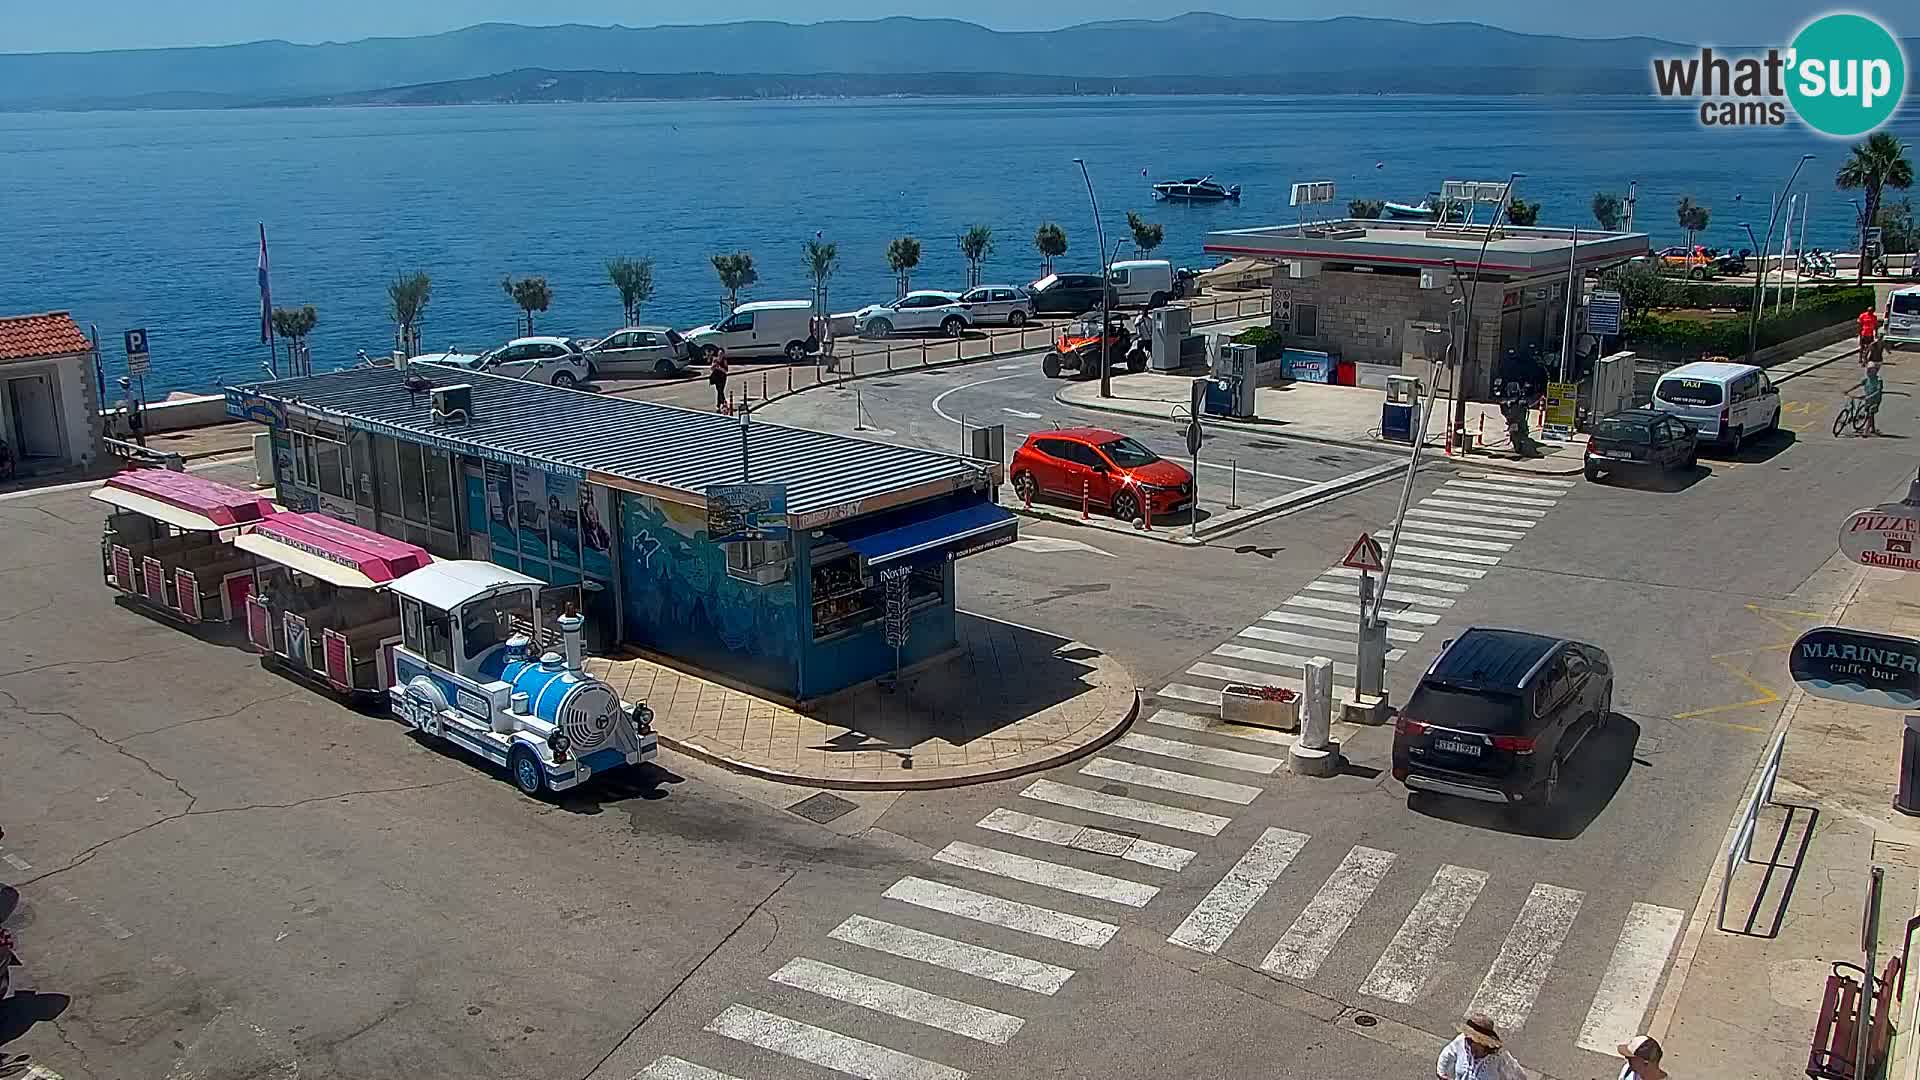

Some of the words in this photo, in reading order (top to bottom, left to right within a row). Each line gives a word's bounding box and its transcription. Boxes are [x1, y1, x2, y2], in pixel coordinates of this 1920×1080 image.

[130, 332, 142, 351] P
[493, 450, 526, 466] STATION
[528, 458, 554, 472] TICKET
[555, 463, 582, 478] OFFICE
[1851, 516, 1920, 533] PIZZE
[1801, 643, 1920, 673] MARINER
[1830, 663, 1866, 674] caffe
[1871, 666, 1899, 680] bar
